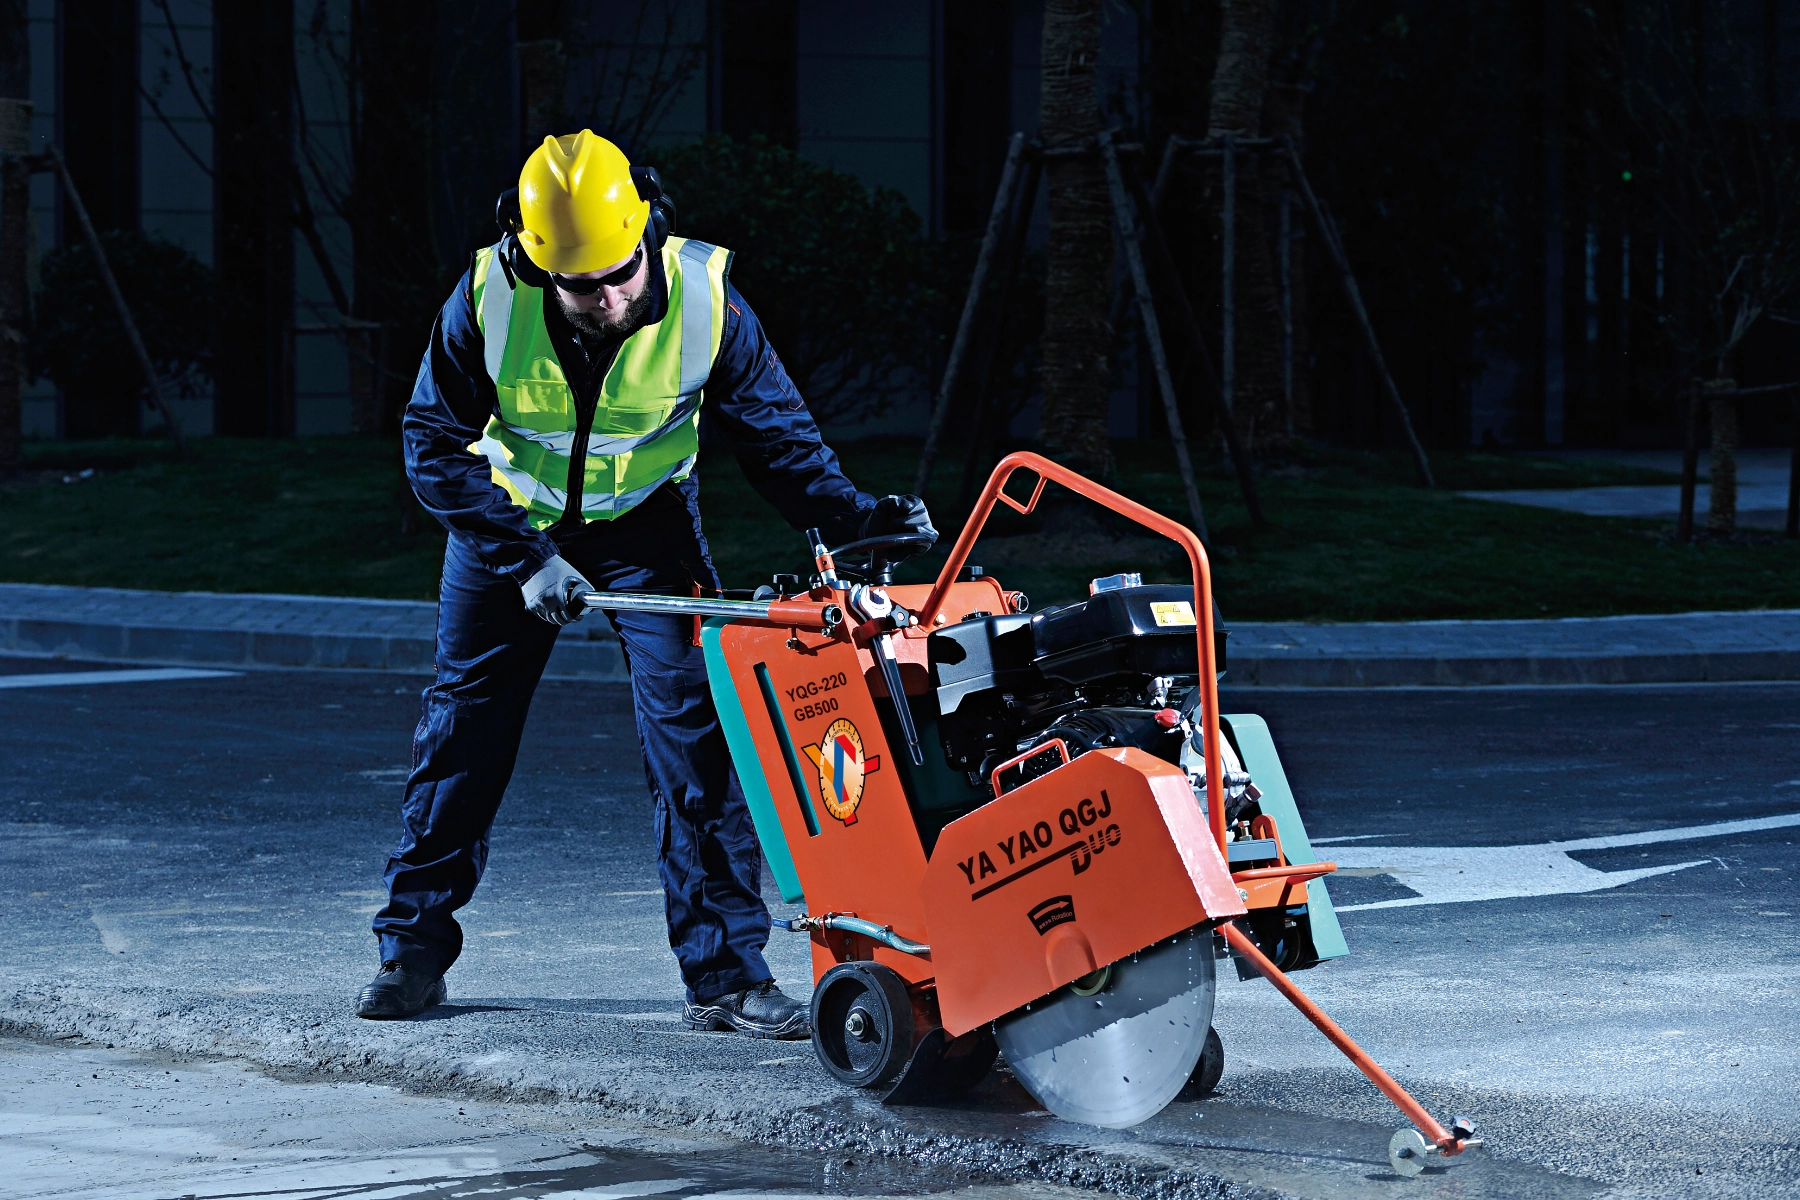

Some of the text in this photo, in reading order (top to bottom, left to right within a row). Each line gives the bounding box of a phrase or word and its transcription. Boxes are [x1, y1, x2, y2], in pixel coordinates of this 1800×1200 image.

[785, 672, 847, 702] YQG-220
[794, 698, 839, 721] GB500
[957, 790, 1112, 885] YA YAO QGJ
[1070, 824, 1121, 876] DUO
[1051, 911, 1073, 922] Rotation
